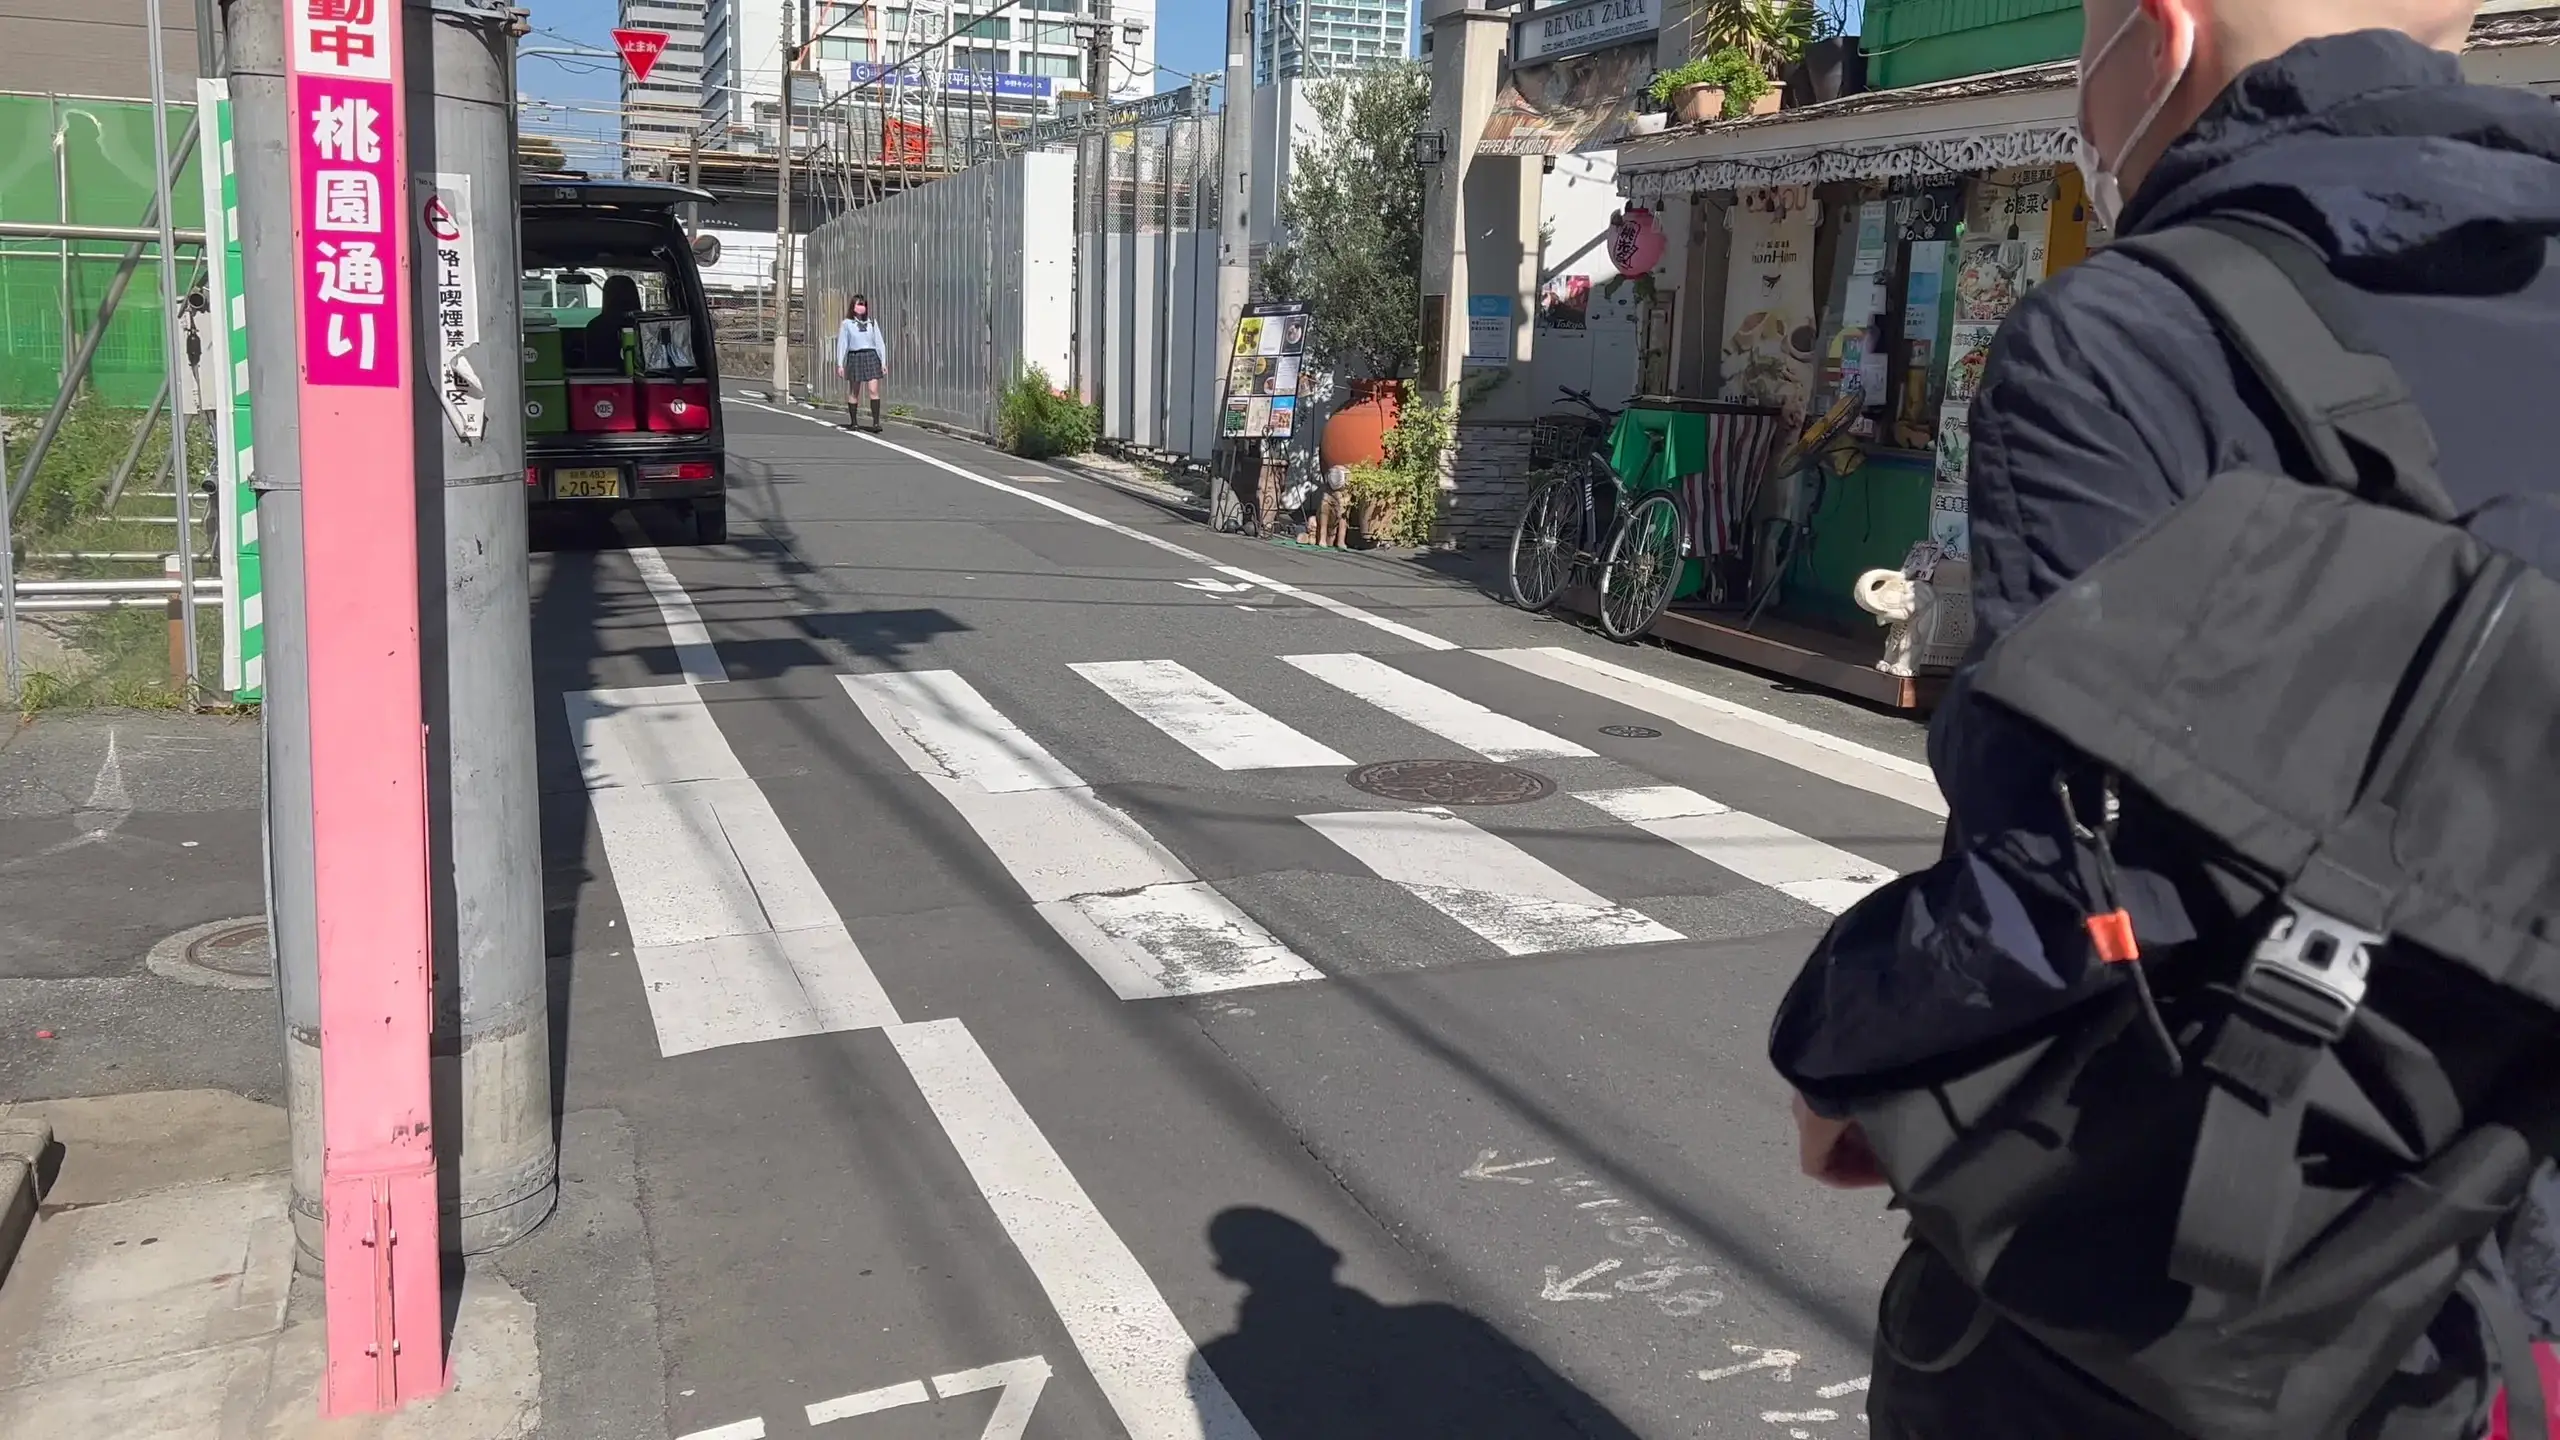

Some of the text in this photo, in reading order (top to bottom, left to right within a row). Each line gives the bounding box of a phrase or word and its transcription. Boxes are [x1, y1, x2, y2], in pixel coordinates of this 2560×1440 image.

[1543, 9, 1595, 38] RENGA
[1601, 0, 1645, 24] ZAKA
[624, 40, 659, 53] 止まれ
[312, 95, 385, 371] 桃園通り
[438, 249, 470, 406] 路上喫煙禁地区
[673, 402, 684, 412] N
[569, 480, 617, 496] 20-57
